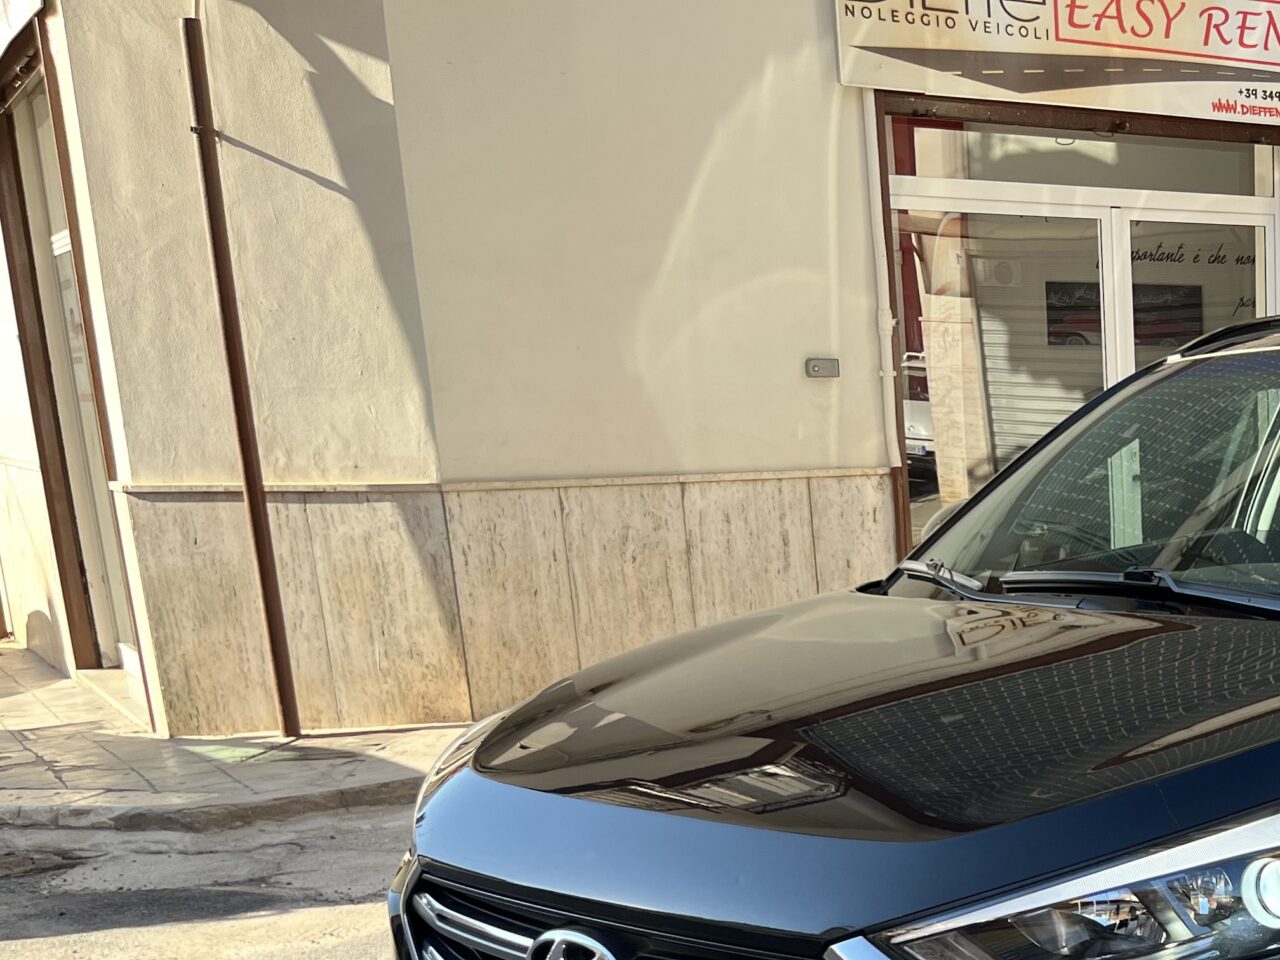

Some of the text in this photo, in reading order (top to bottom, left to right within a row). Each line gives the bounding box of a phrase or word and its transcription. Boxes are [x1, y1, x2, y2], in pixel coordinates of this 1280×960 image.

[844, 4, 956, 30] NOLEGGIO
[968, 18, 1050, 41] VEICOLI
[1065, 0, 1186, 40] EASY
[1238, 88, 1258, 99] +39
[1261, 90, 1280, 102] 349
[1131, 241, 1185, 265] portante
[1207, 243, 1227, 264] che
